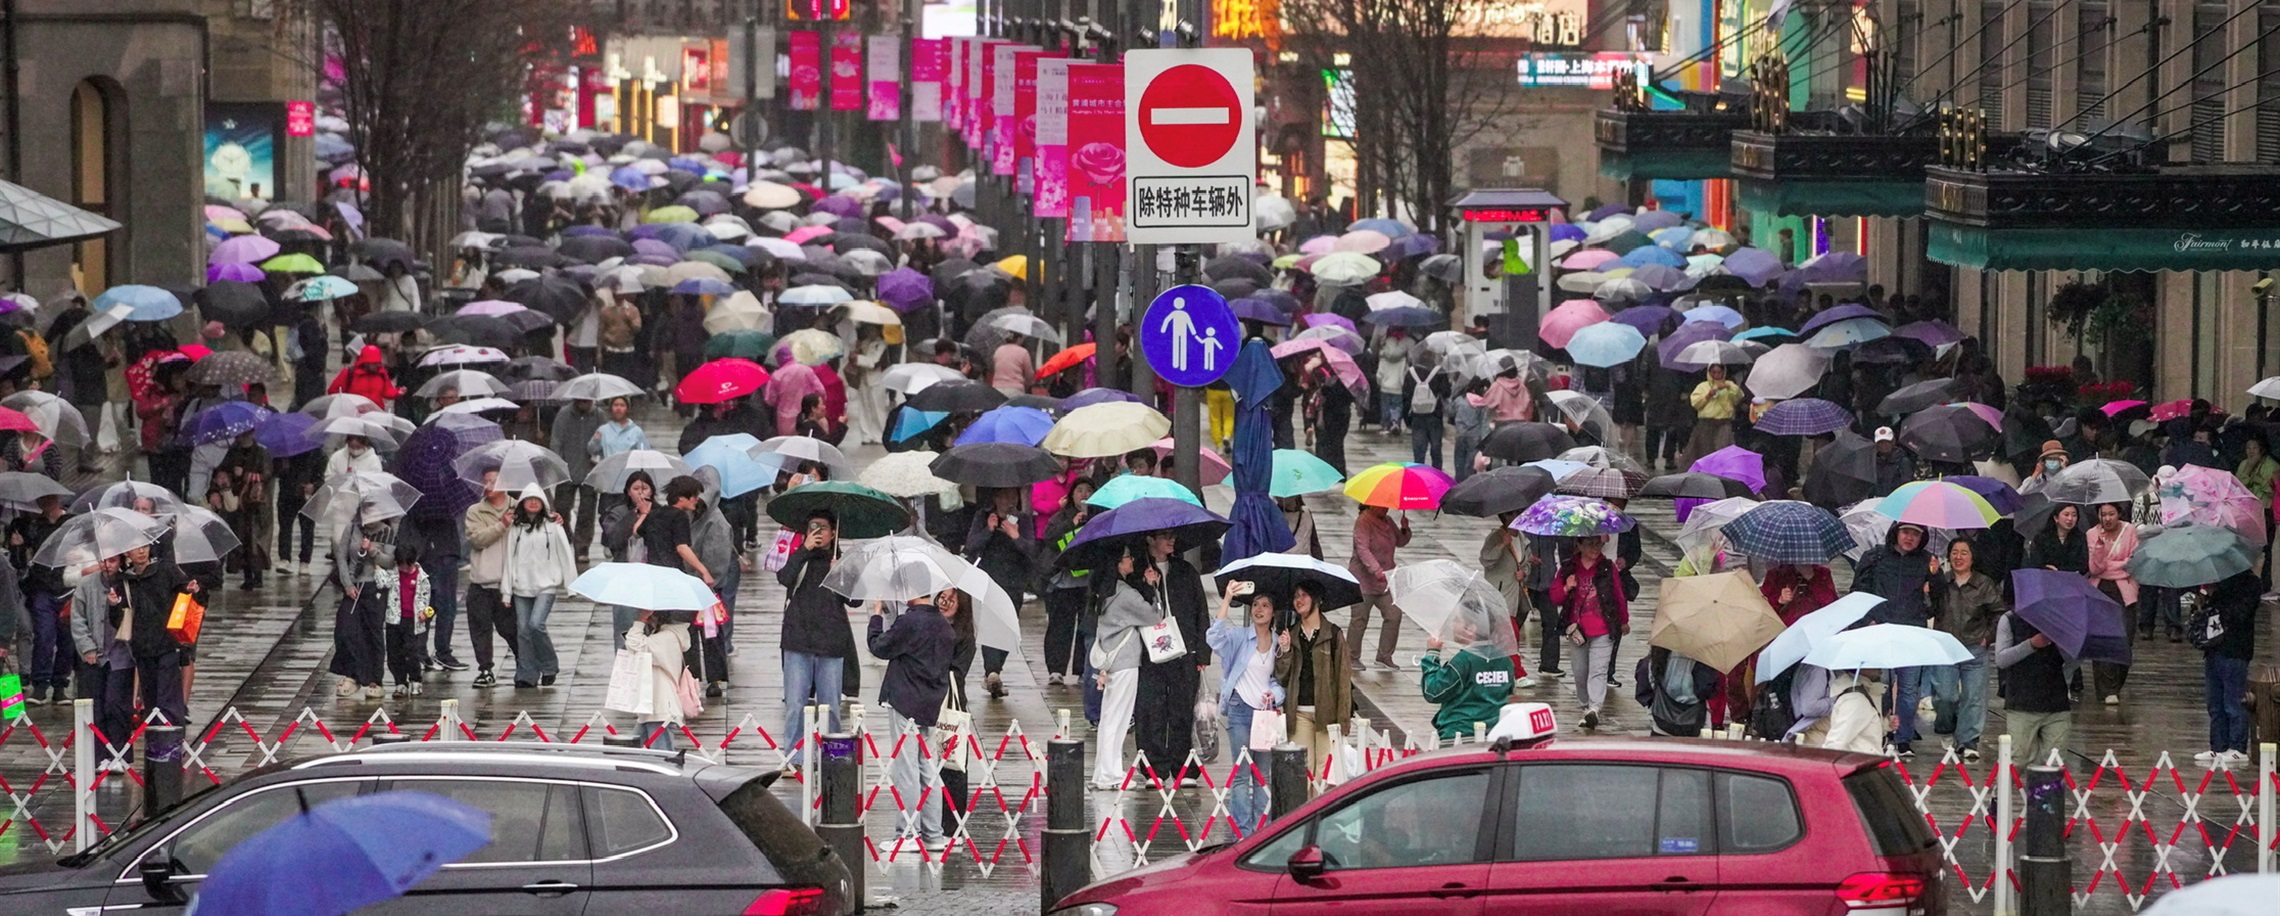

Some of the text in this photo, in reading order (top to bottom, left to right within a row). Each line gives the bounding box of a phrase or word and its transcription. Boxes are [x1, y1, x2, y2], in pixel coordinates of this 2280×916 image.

[1139, 186, 1243, 218] 除特种车辆外
[2174, 232, 2233, 252] Fairmont
[1533, 712, 1552, 730] TAXI
